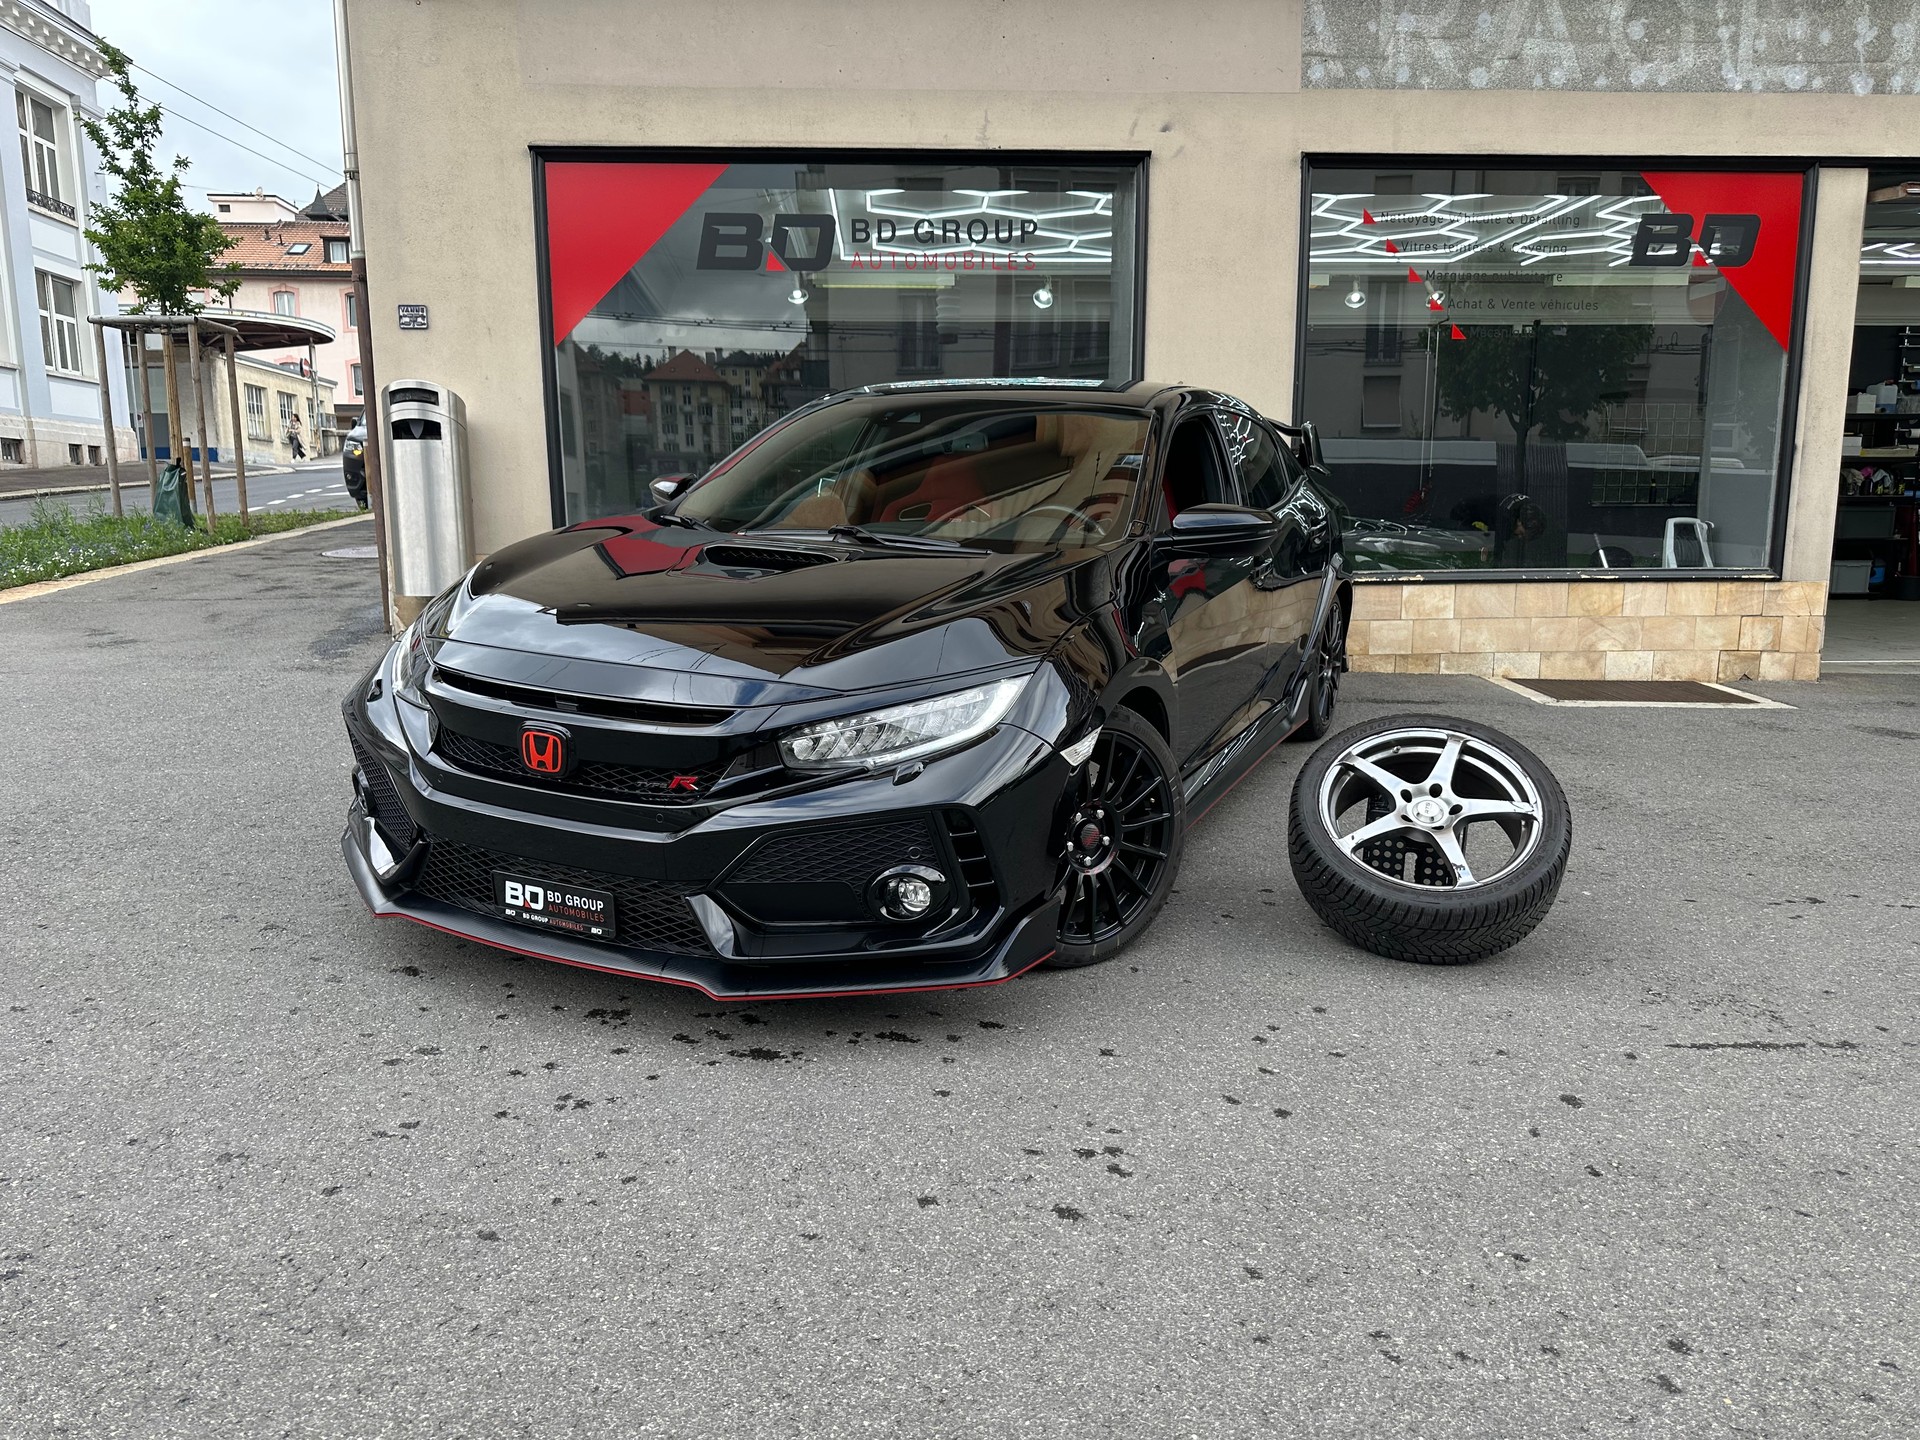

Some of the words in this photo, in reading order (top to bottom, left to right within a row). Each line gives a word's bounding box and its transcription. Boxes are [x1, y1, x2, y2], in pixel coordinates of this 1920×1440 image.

[1380, 212, 1444, 227] Nettoyage
[1506, 214, 1516, 225] &
[850, 218, 897, 244] BD
[913, 218, 1039, 245] GROUP
[1628, 213, 1761, 267] BD
[696, 212, 836, 271] BD
[1401, 241, 1438, 253] Vitres
[1499, 242, 1508, 253] &
[1511, 242, 1568, 256] Covering
[850, 251, 1037, 271] AUTOMOBILES
[1425, 269, 1488, 283] Marquage
[1492, 270, 1563, 284] publicitaire
[1448, 299, 1482, 310] Achat
[1487, 299, 1496, 310] &
[1501, 299, 1535, 310] Vente
[1540, 298, 1599, 311] véhicules
[1342, 720, 1397, 745] DUNLOP
[668, 776, 699, 791] R
[505, 880, 544, 910] BD
[547, 890, 562, 904] BD
[565, 894, 604, 912] GROUP
[531, 914, 548, 923] GROUP
[549, 918, 584, 931] AUTOMOBILES
[548, 904, 605, 923] AUTOMOBILES
